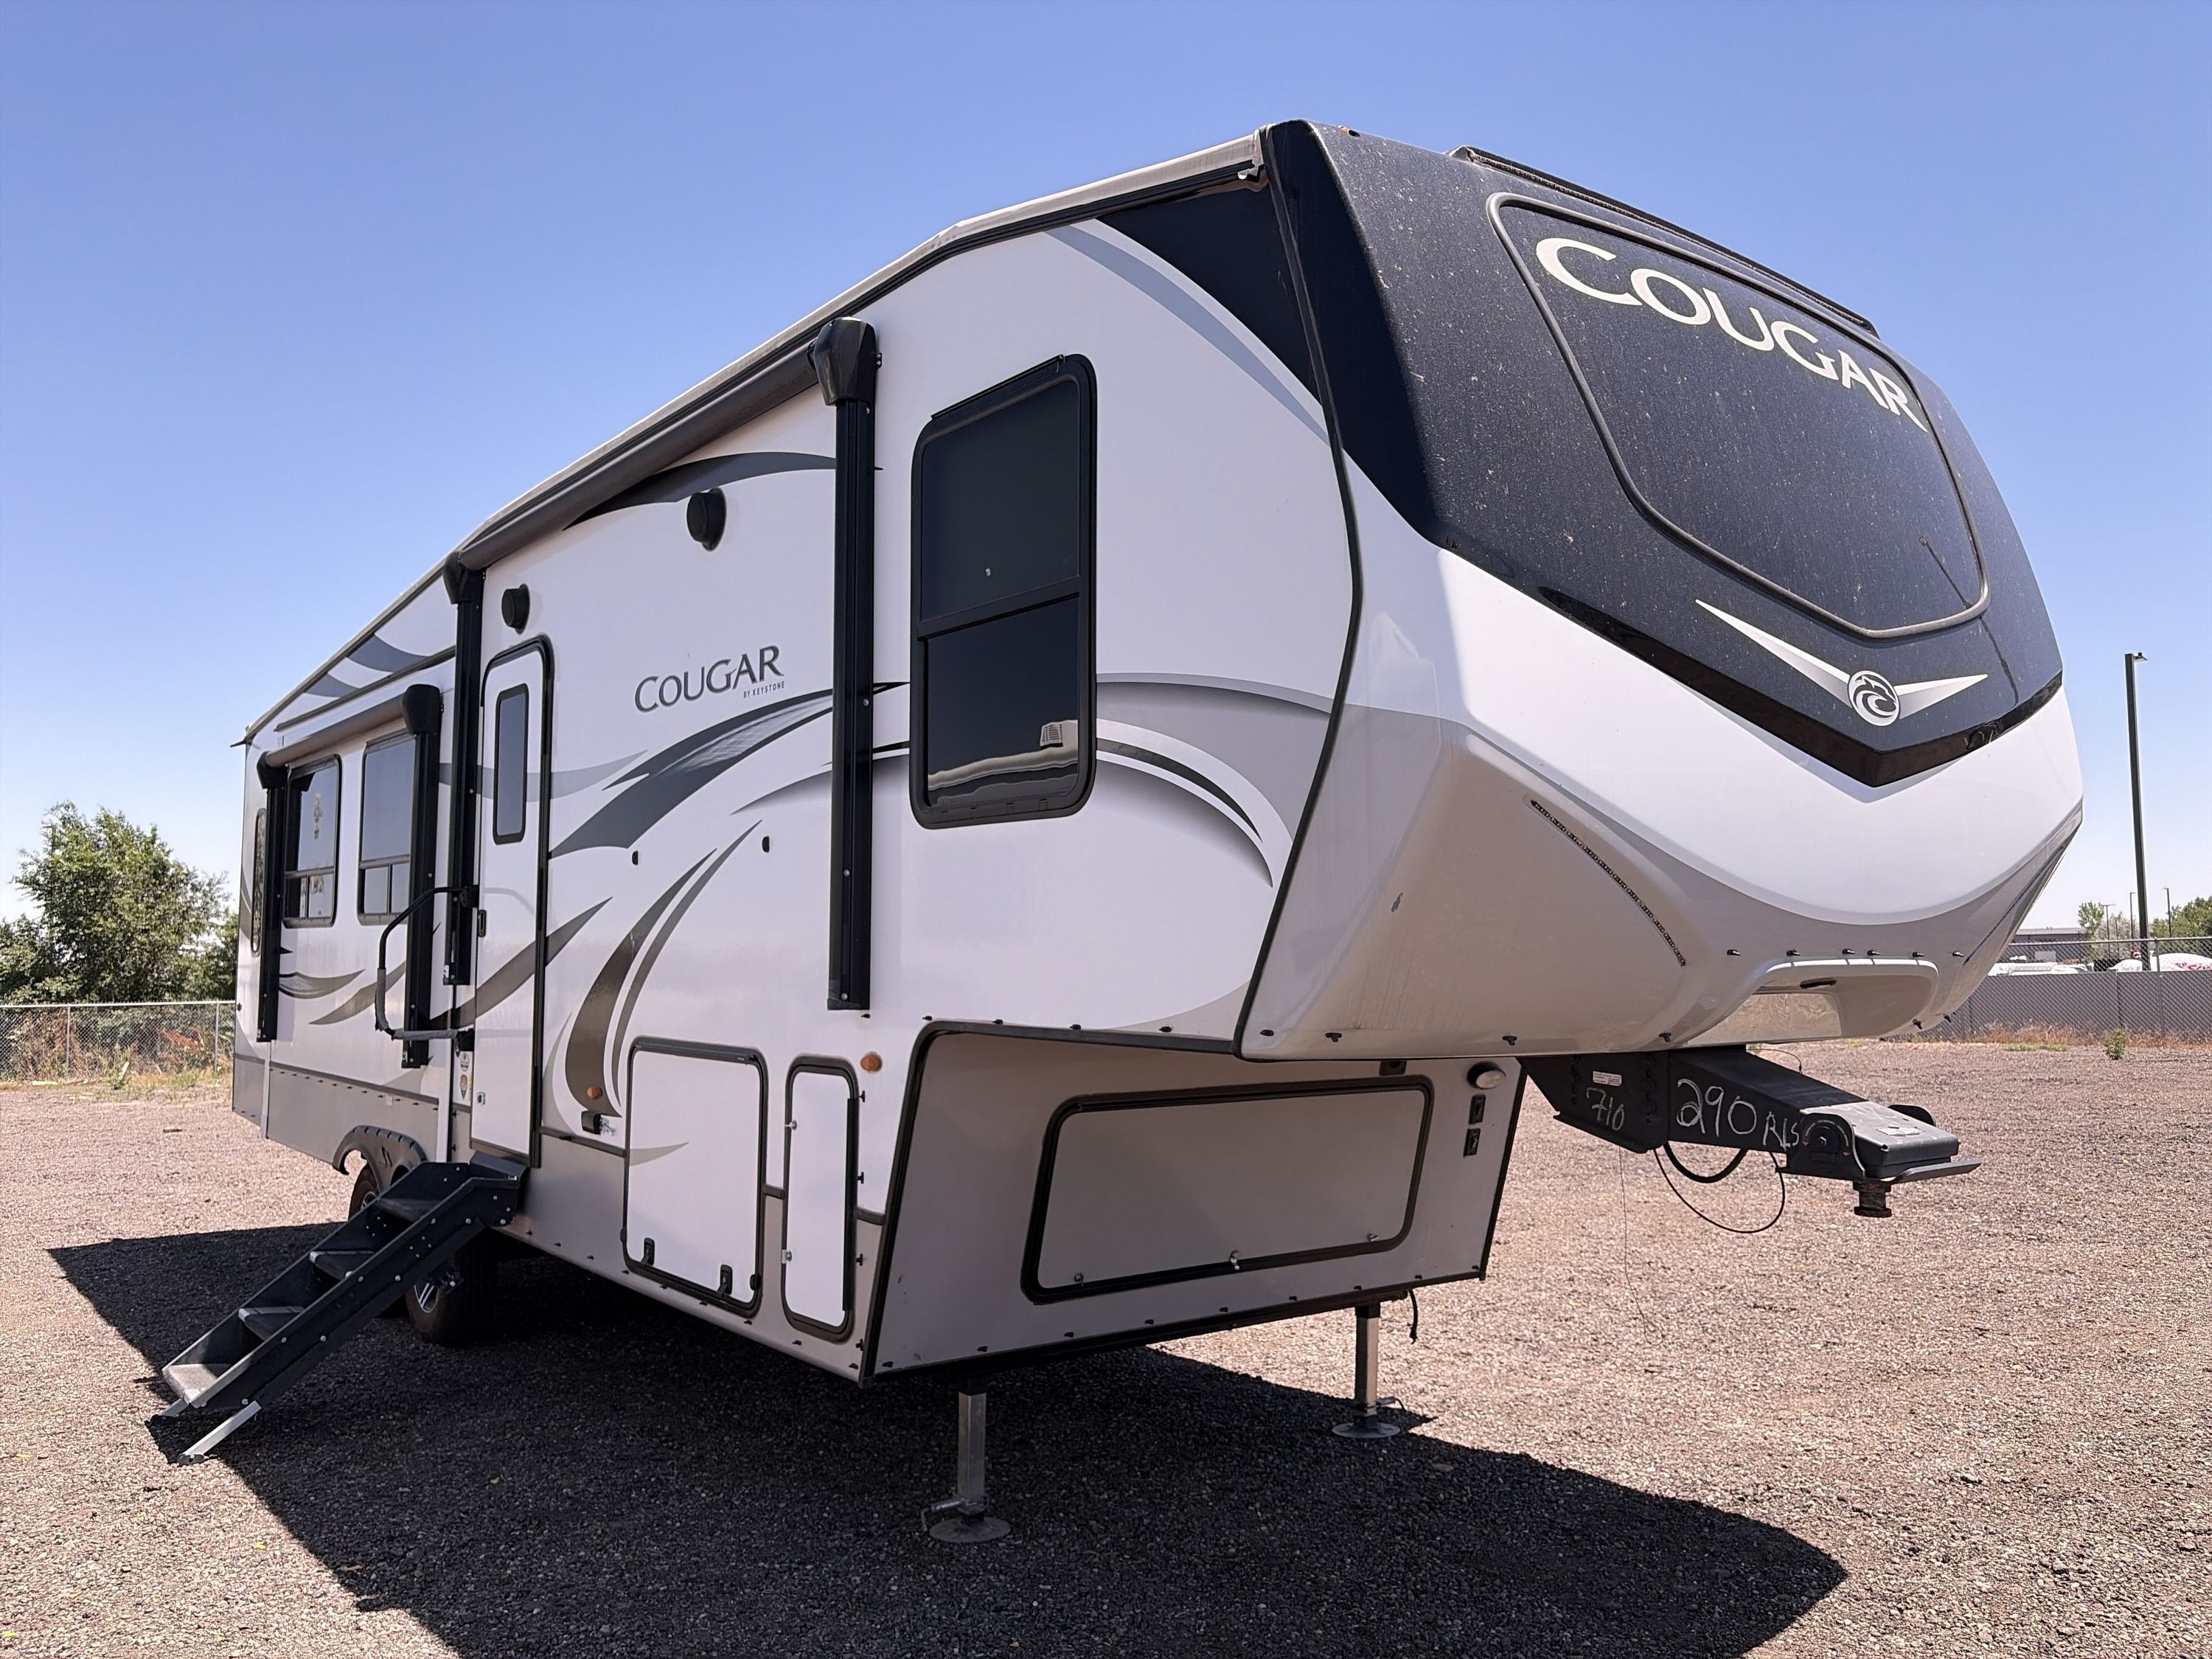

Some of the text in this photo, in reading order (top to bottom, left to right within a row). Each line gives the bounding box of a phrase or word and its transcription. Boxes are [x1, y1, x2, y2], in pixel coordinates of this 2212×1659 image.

[1536, 237, 1928, 432] COUGAR
[635, 645, 785, 712] COUGAR
[743, 681, 785, 698] BY KEYSTONE
[1586, 1088, 1624, 1130] 710
[1677, 1078, 1757, 1137] 290
